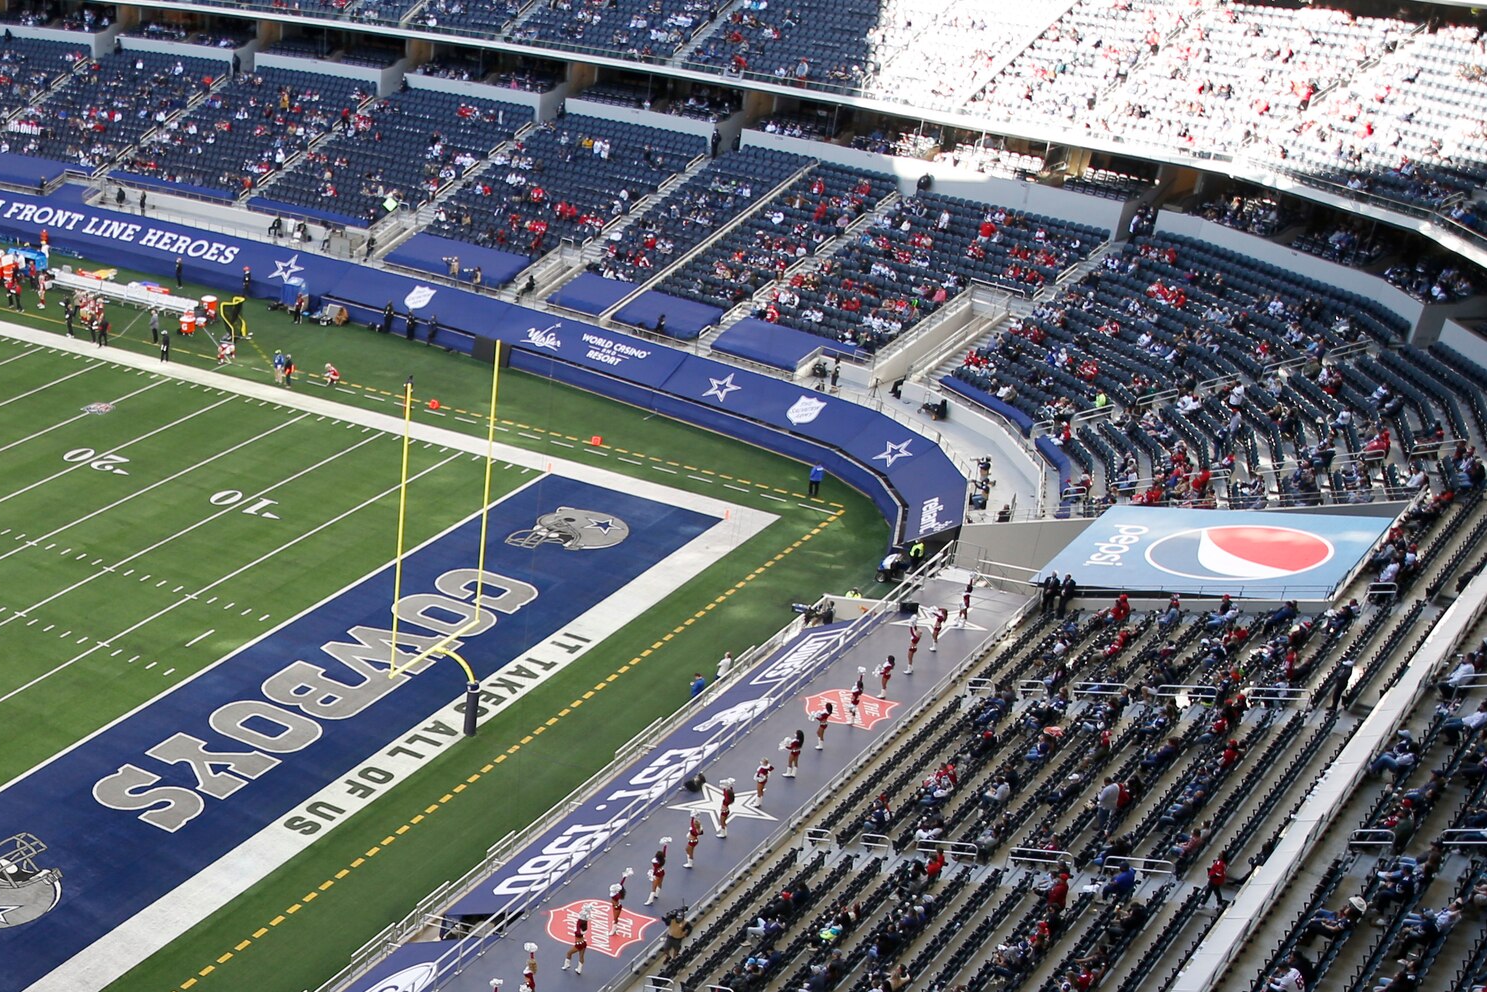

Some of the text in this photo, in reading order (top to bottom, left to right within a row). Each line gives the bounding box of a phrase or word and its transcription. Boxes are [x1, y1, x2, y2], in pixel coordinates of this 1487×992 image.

[3, 200, 88, 234] FRONT
[83, 213, 142, 242] LINE
[139, 226, 239, 265] HEROES
[582, 333, 650, 360] WORLD CASINO
[586, 350, 624, 366] RESORT
[62, 447, 129, 473] 20
[210, 489, 272, 520] 10
[919, 496, 944, 535] reliant
[1083, 524, 1149, 567] pepsi
[92, 568, 539, 833] COWBOYS
[862, 701, 881, 717] THE
[283, 632, 592, 836] IT TAKES ALL OF US
[492, 741, 720, 896] EST. 1960
[591, 901, 612, 952] SALVATION
[615, 917, 633, 938] THE
